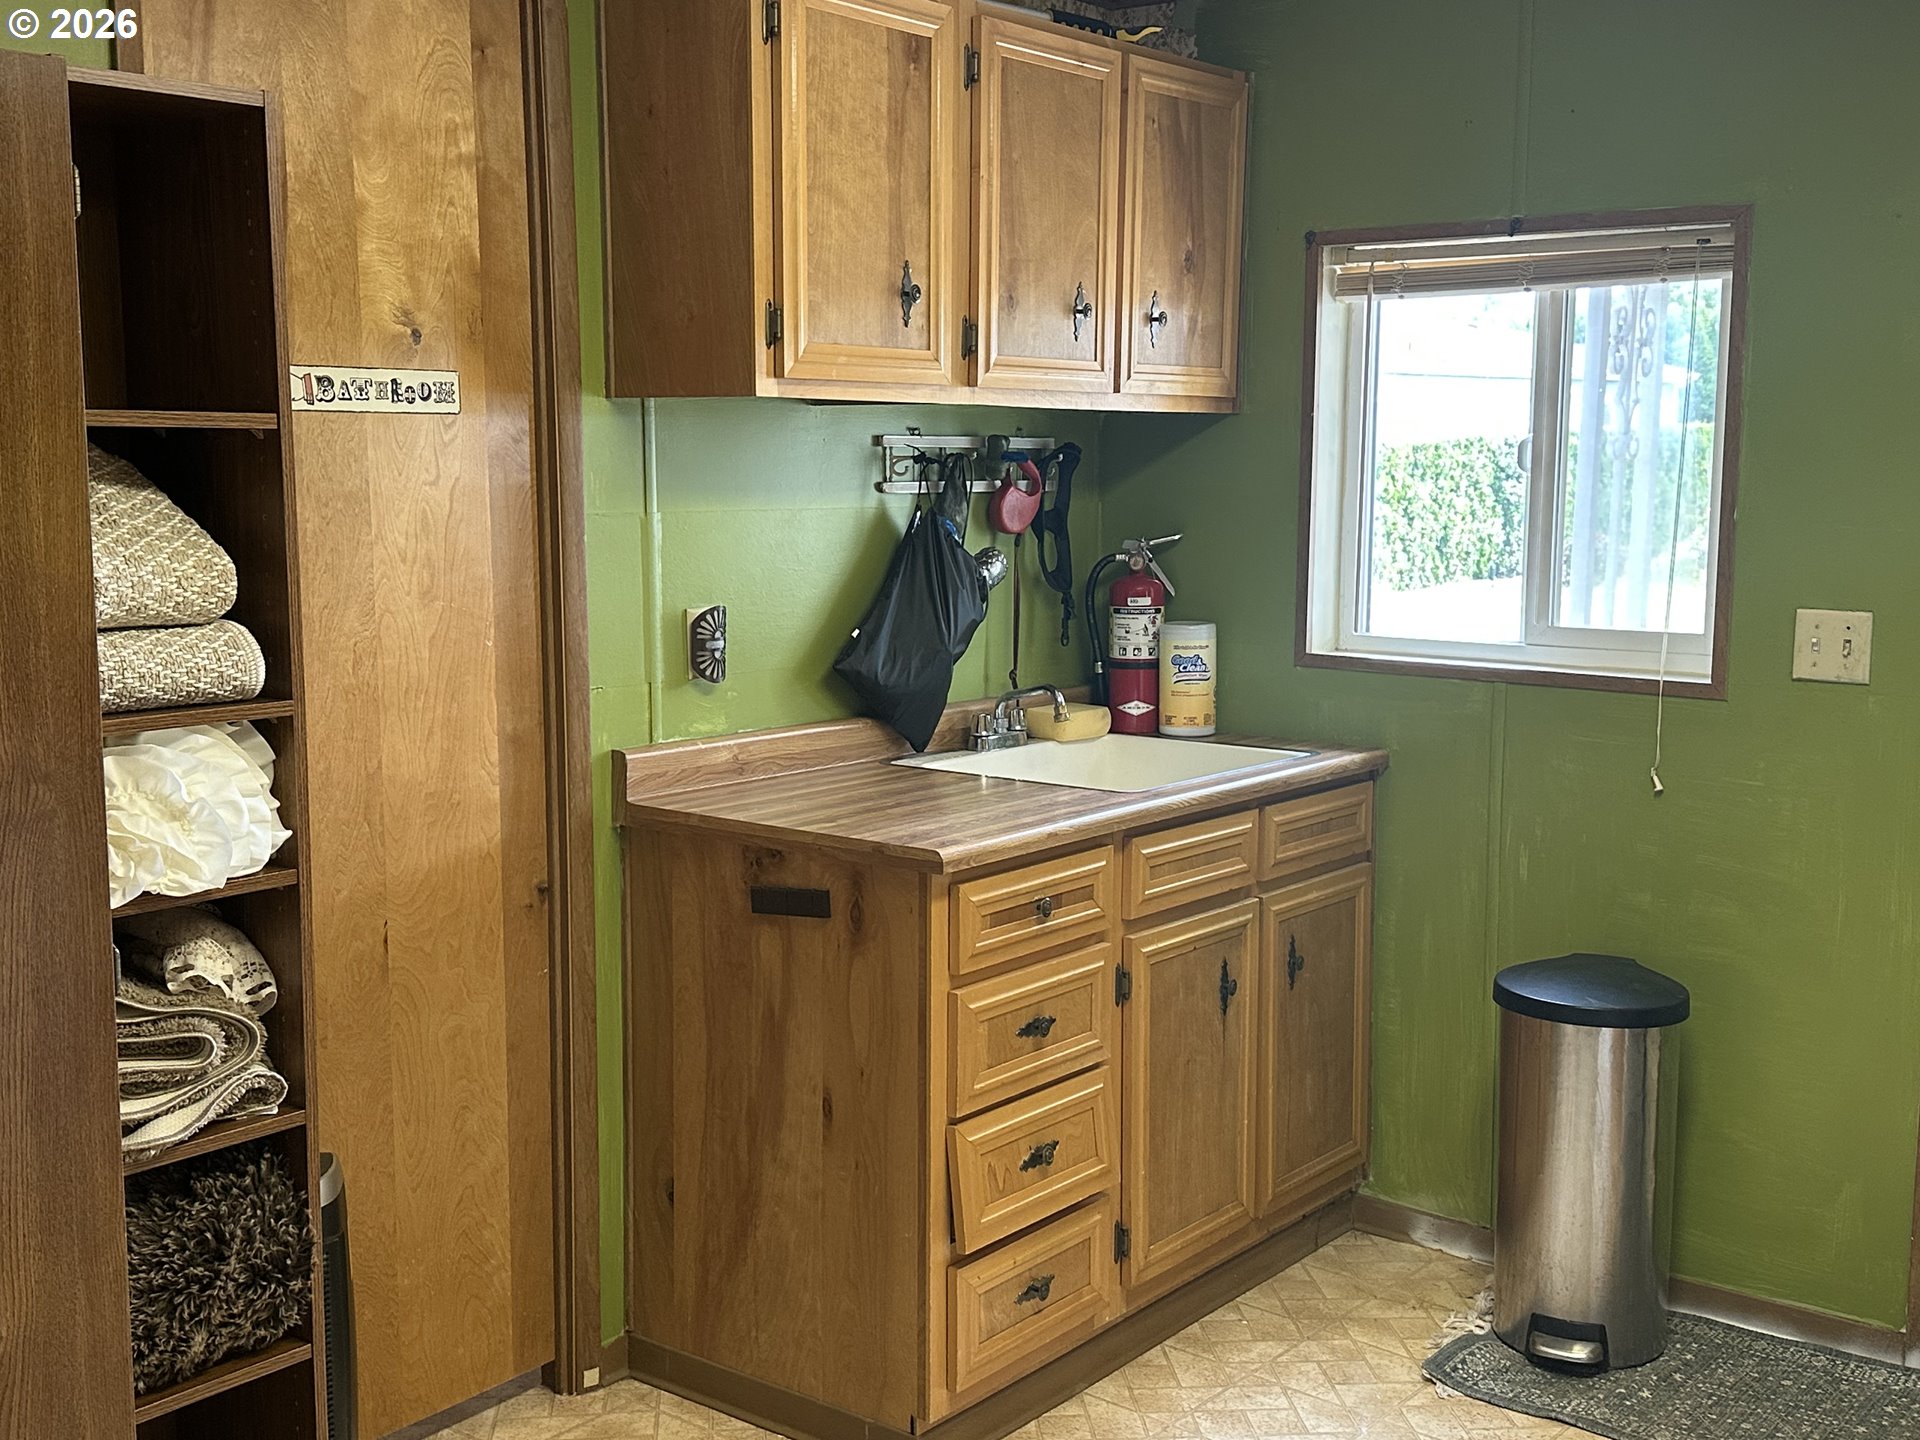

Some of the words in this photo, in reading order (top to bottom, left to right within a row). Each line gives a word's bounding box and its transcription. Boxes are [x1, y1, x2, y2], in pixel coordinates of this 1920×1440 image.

[314, 374, 456, 405] BATHROOM
[1171, 654, 1199, 665] Good
[1179, 663, 1206, 672] Clean
